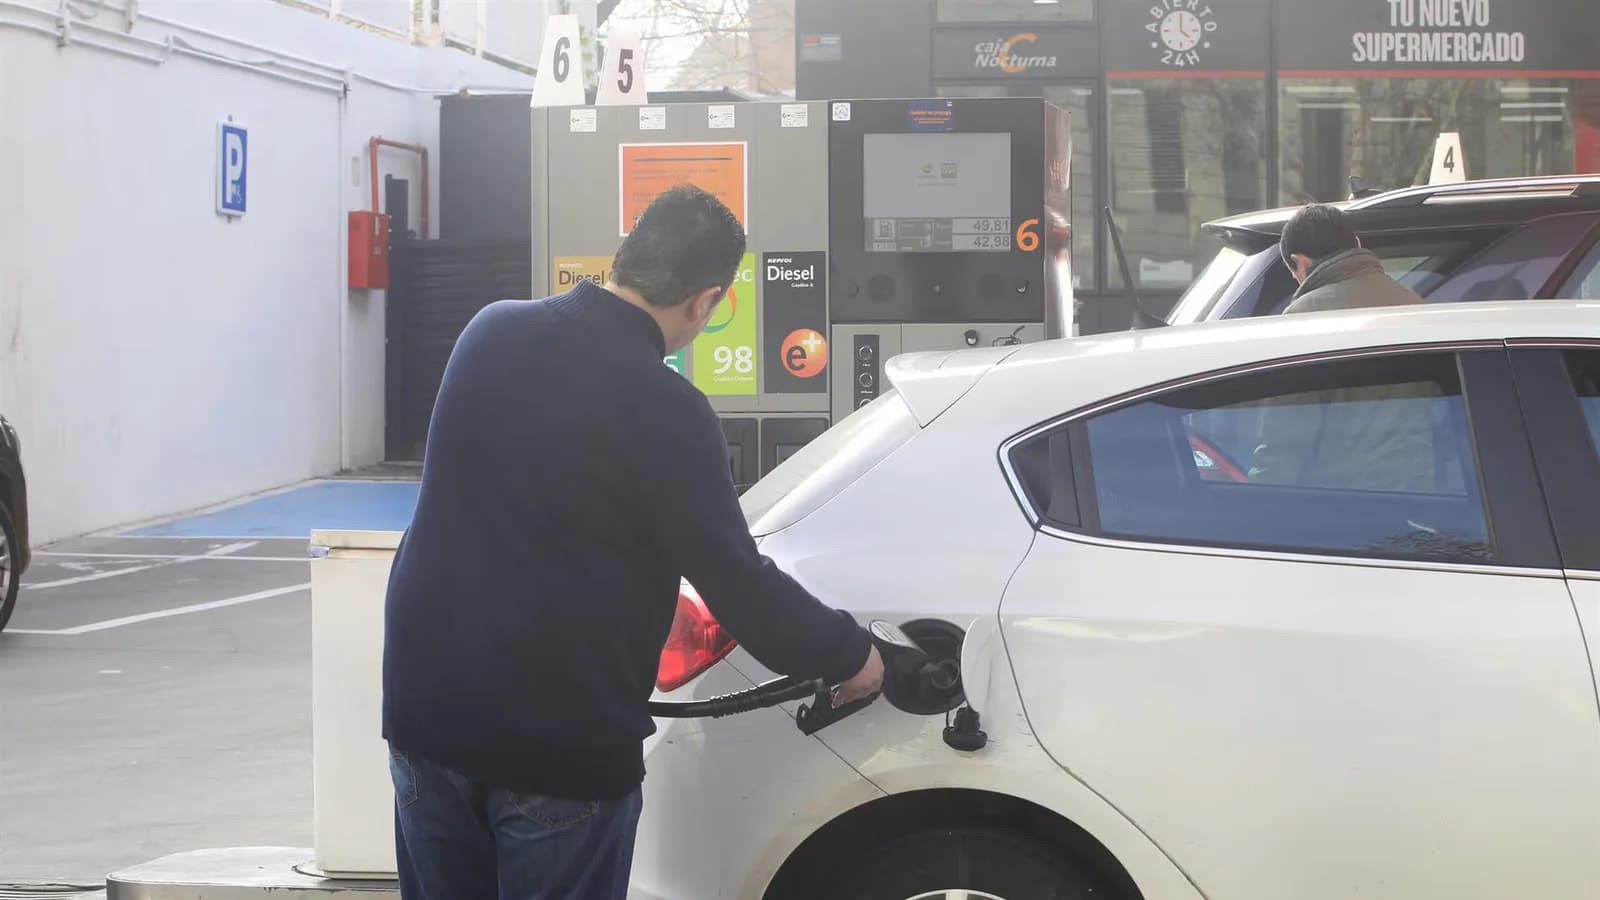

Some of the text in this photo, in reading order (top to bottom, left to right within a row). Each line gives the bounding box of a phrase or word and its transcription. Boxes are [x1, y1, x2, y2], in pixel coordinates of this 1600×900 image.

[1144, 0, 1217, 33] ABIERTO
[1387, 0, 1490, 27] TU NUEVO
[553, 36, 571, 83] 6
[975, 54, 1057, 68] Nocturna
[1160, 50, 1200, 67] 24H
[1352, 32, 1525, 62] SUPERMERCADO
[617, 48, 633, 94] 5
[226, 132, 243, 203] P
[1443, 145, 1455, 173] 4
[974, 220, 1009, 232] 49,81
[1016, 218, 1040, 251] 6
[974, 236, 1010, 248] 42,98
[767, 264, 814, 281] Diesel
[713, 345, 753, 374] 98
